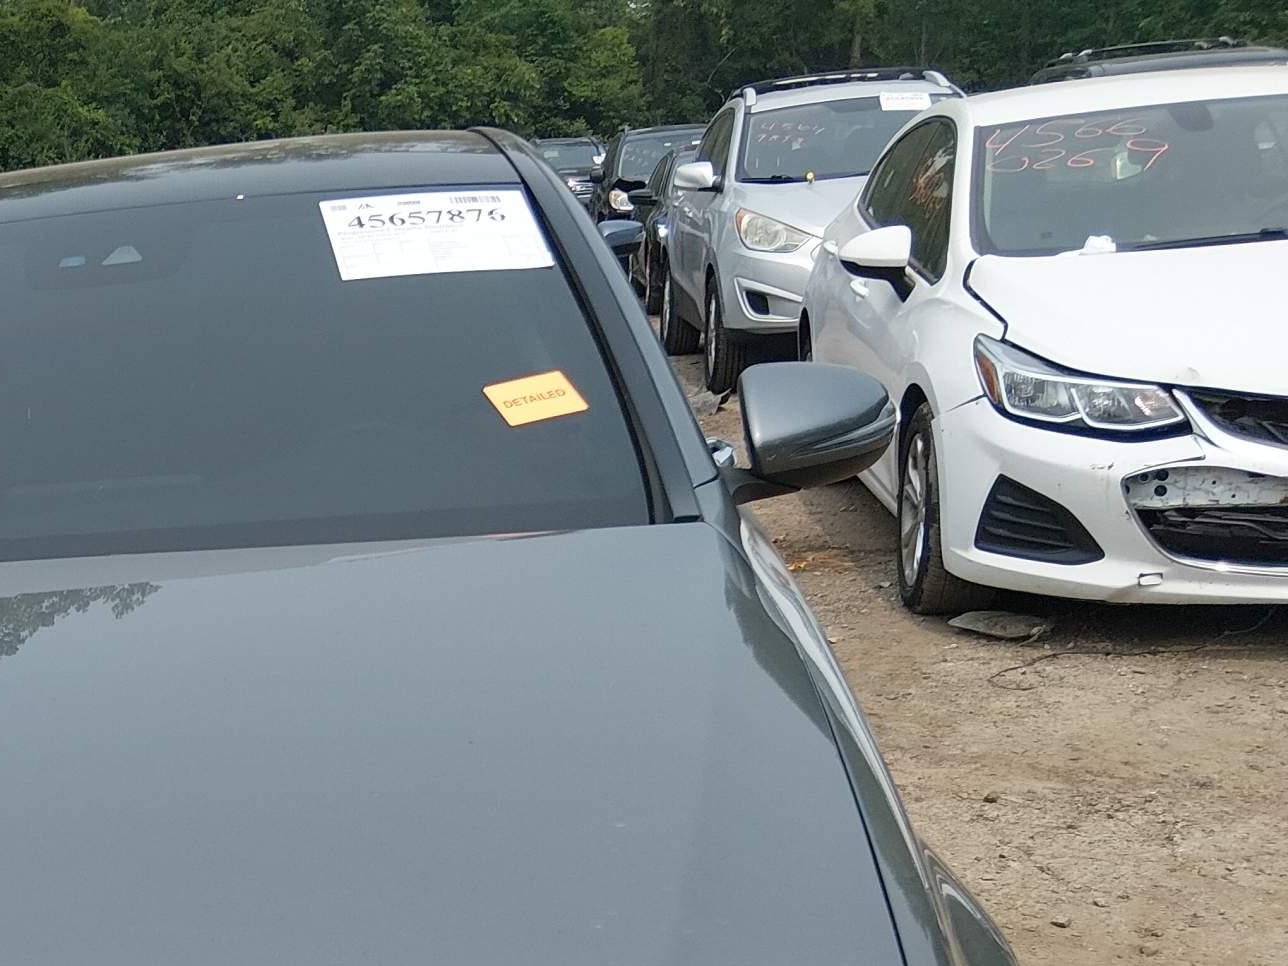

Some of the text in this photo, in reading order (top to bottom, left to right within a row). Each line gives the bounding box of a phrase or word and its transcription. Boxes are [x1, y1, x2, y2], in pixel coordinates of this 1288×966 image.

[985, 117, 1149, 156] 4566
[986, 138, 1169, 172] 0269
[347, 207, 507, 229] 45657876
[503, 388, 566, 409] DETAILED
